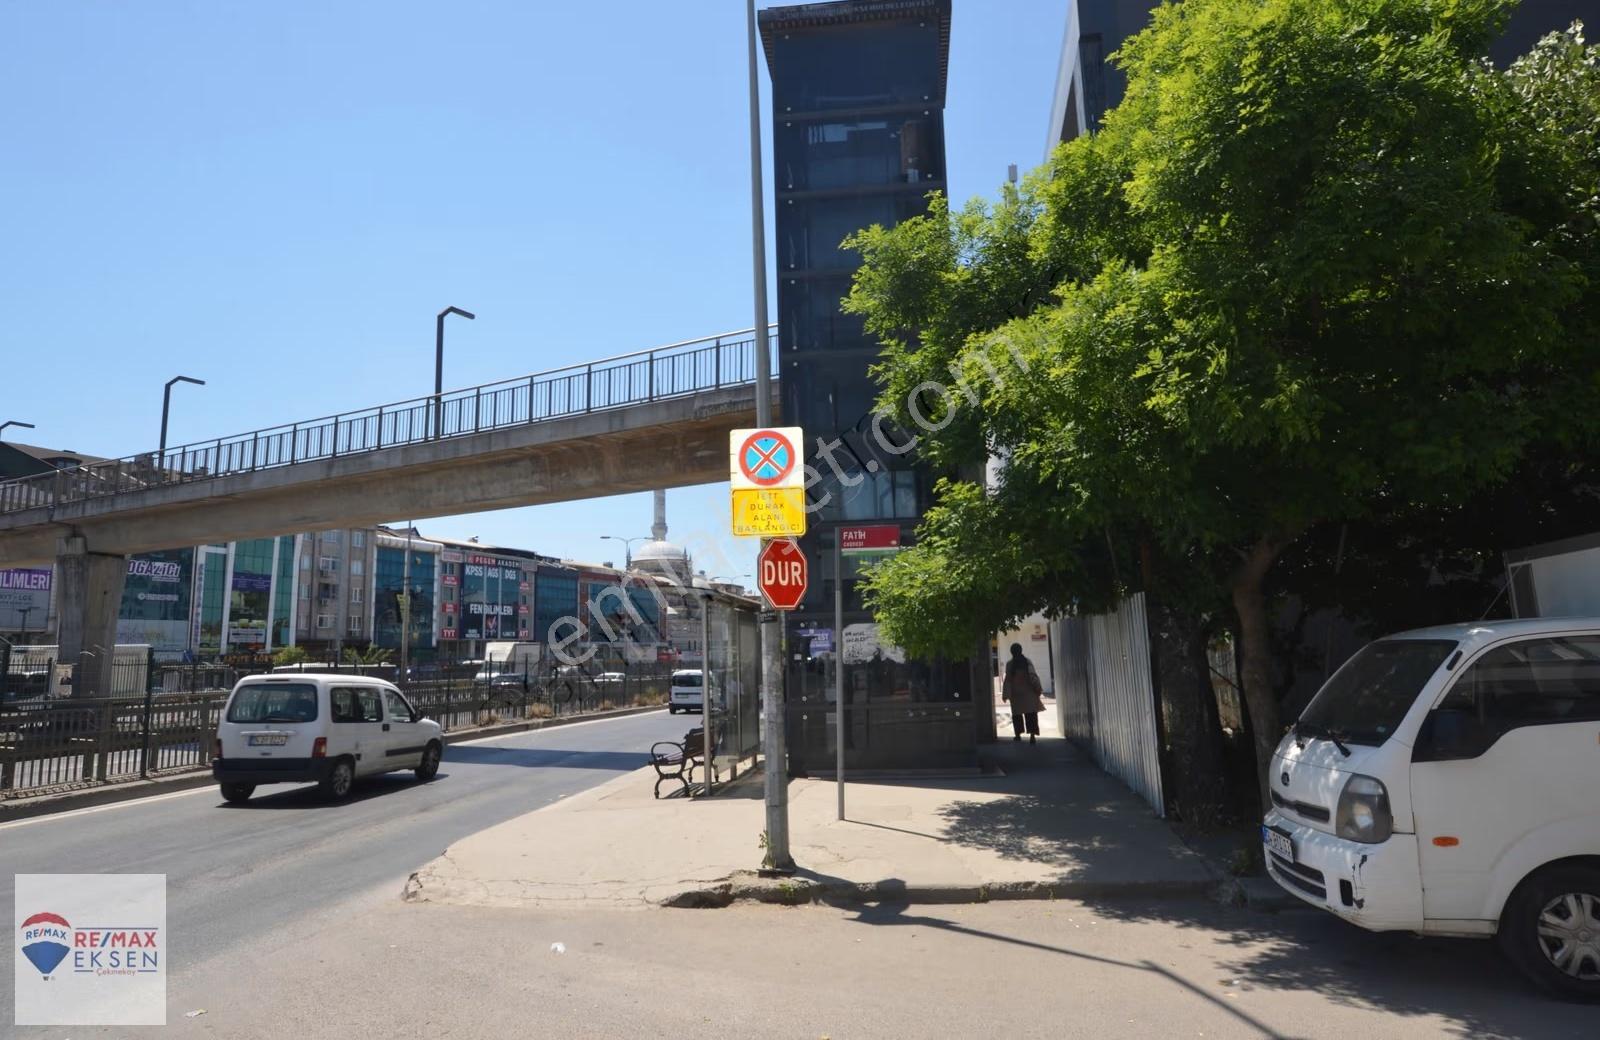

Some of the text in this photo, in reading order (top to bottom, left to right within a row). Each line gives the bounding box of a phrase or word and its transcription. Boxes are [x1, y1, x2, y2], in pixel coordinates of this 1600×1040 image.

[750, 503, 785, 511] DURAK
[465, 565, 483, 576] KPSS
[764, 560, 803, 586] DUR
[469, 603, 483, 614] FEN
[443, 629, 456, 637] TYT
